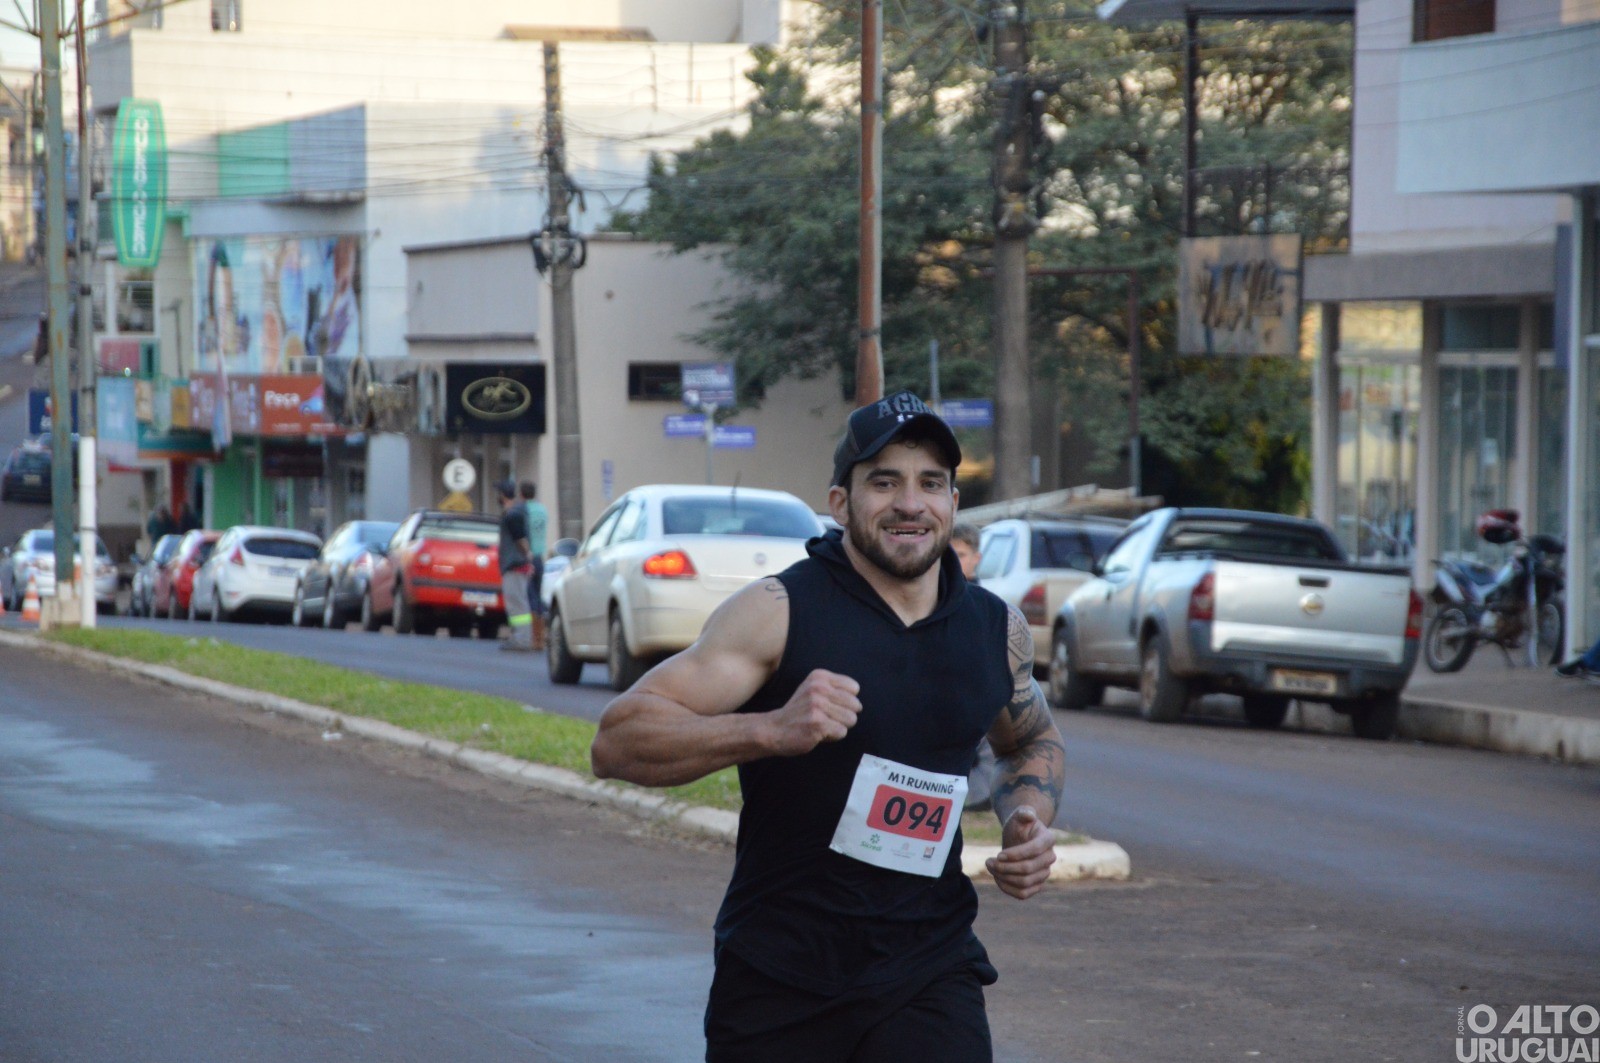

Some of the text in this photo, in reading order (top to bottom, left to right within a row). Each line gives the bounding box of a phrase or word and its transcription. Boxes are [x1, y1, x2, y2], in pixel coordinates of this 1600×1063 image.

[265, 390, 300, 409] Peça
[453, 465, 465, 483] E
[883, 796, 946, 834] 094
